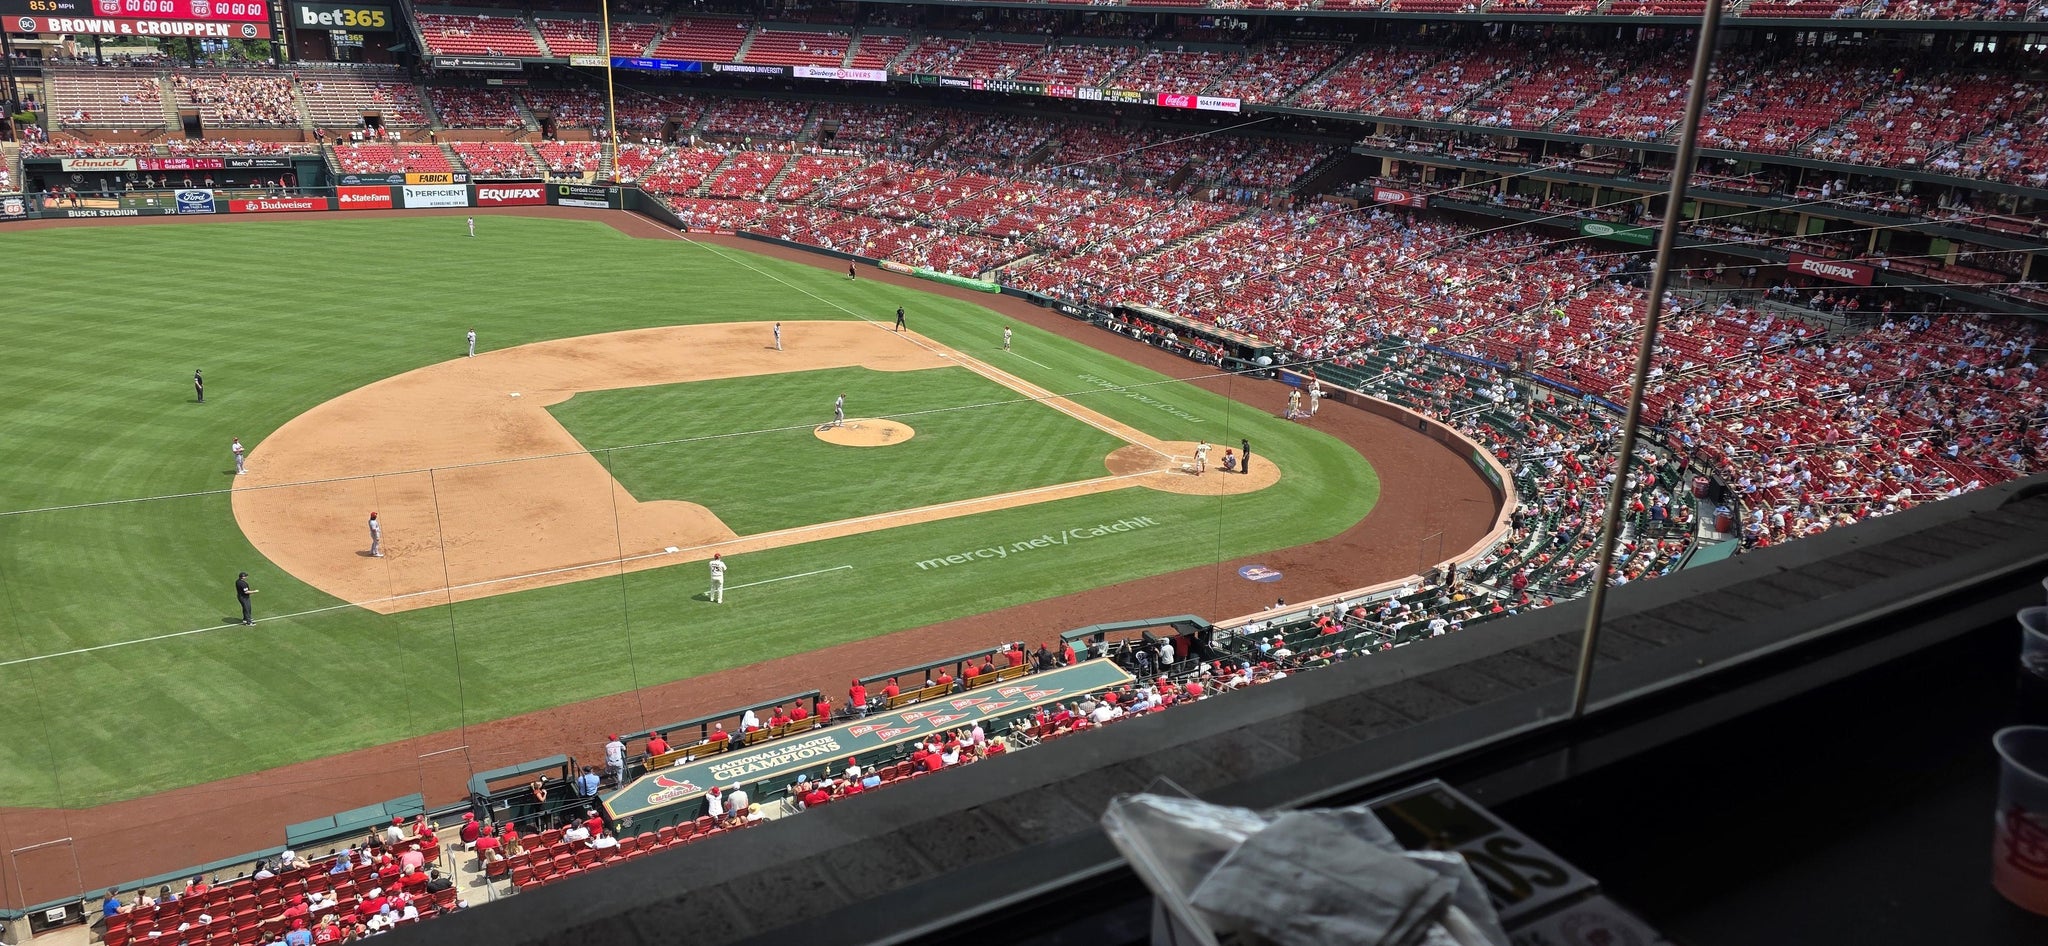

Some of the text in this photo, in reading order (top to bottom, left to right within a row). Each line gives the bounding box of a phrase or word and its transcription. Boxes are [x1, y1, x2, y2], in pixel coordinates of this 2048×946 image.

[30, 0, 57, 11] 85.9
[126, 0, 174, 12] GO GO GO
[195, 6, 207, 14] 66
[216, 3, 261, 15] GO GO GO
[301, 6, 385, 28] bet365
[22, 20, 34, 28] BC
[48, 18, 229, 36] BROWN & CROUPPEN
[243, 26, 255, 35] BC
[722, 64, 783, 74] LINDENWOOD UNIVERSITY
[67, 159, 129, 167] Schnucks
[419, 174, 448, 182] FABICK
[453, 174, 466, 182] CAT
[183, 192, 205, 201] Ford
[415, 189, 465, 197] PERFICIENT
[478, 188, 541, 201] EQUIFAX
[261, 200, 312, 209] Budweiser
[1802, 259, 1856, 279] EQUIFAX
[915, 516, 1161, 570] mercy.net/CatchIt
[708, 735, 834, 773] NATIONAL LEAGUE
[713, 741, 841, 781] CHAMPIONS
[649, 785, 702, 804] Cardinals
